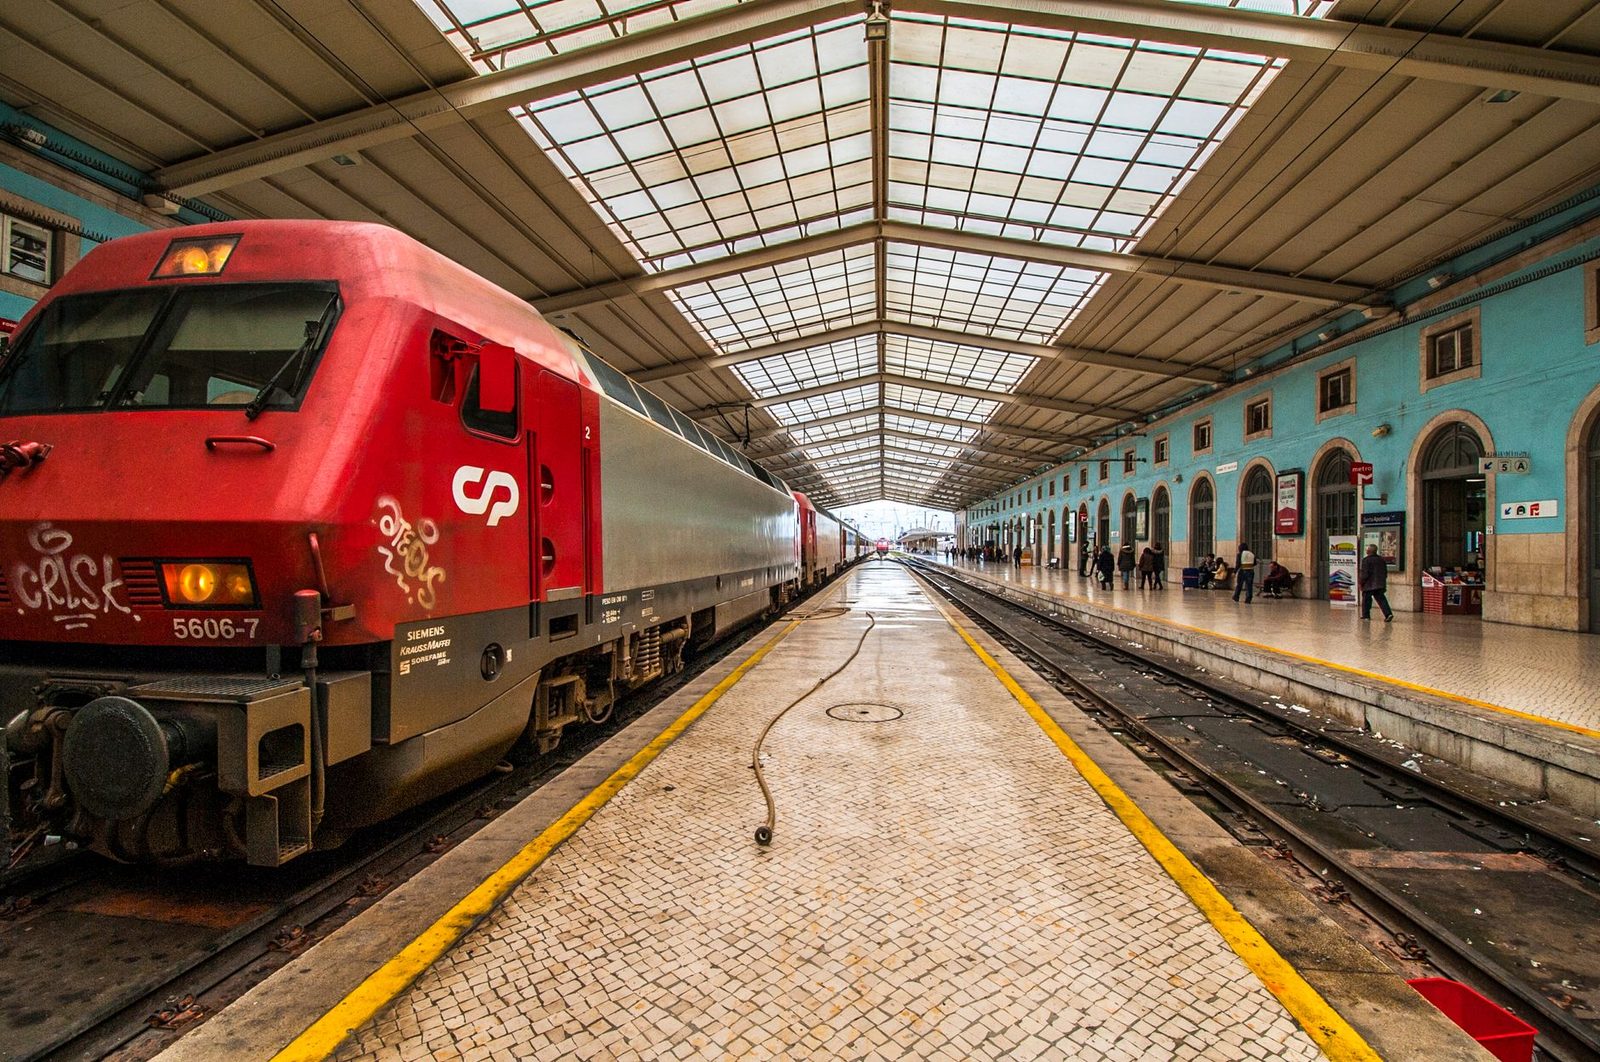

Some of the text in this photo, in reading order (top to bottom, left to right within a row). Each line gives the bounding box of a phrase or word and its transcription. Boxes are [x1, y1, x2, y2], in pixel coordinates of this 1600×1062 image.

[585, 426, 590, 440] 2
[1352, 465, 1373, 473] metro
[1502, 462, 1525, 471] 5 A
[172, 617, 260, 640] 5606-7
[407, 625, 445, 641] SIEMENS
[411, 651, 447, 665] SOREFAME
